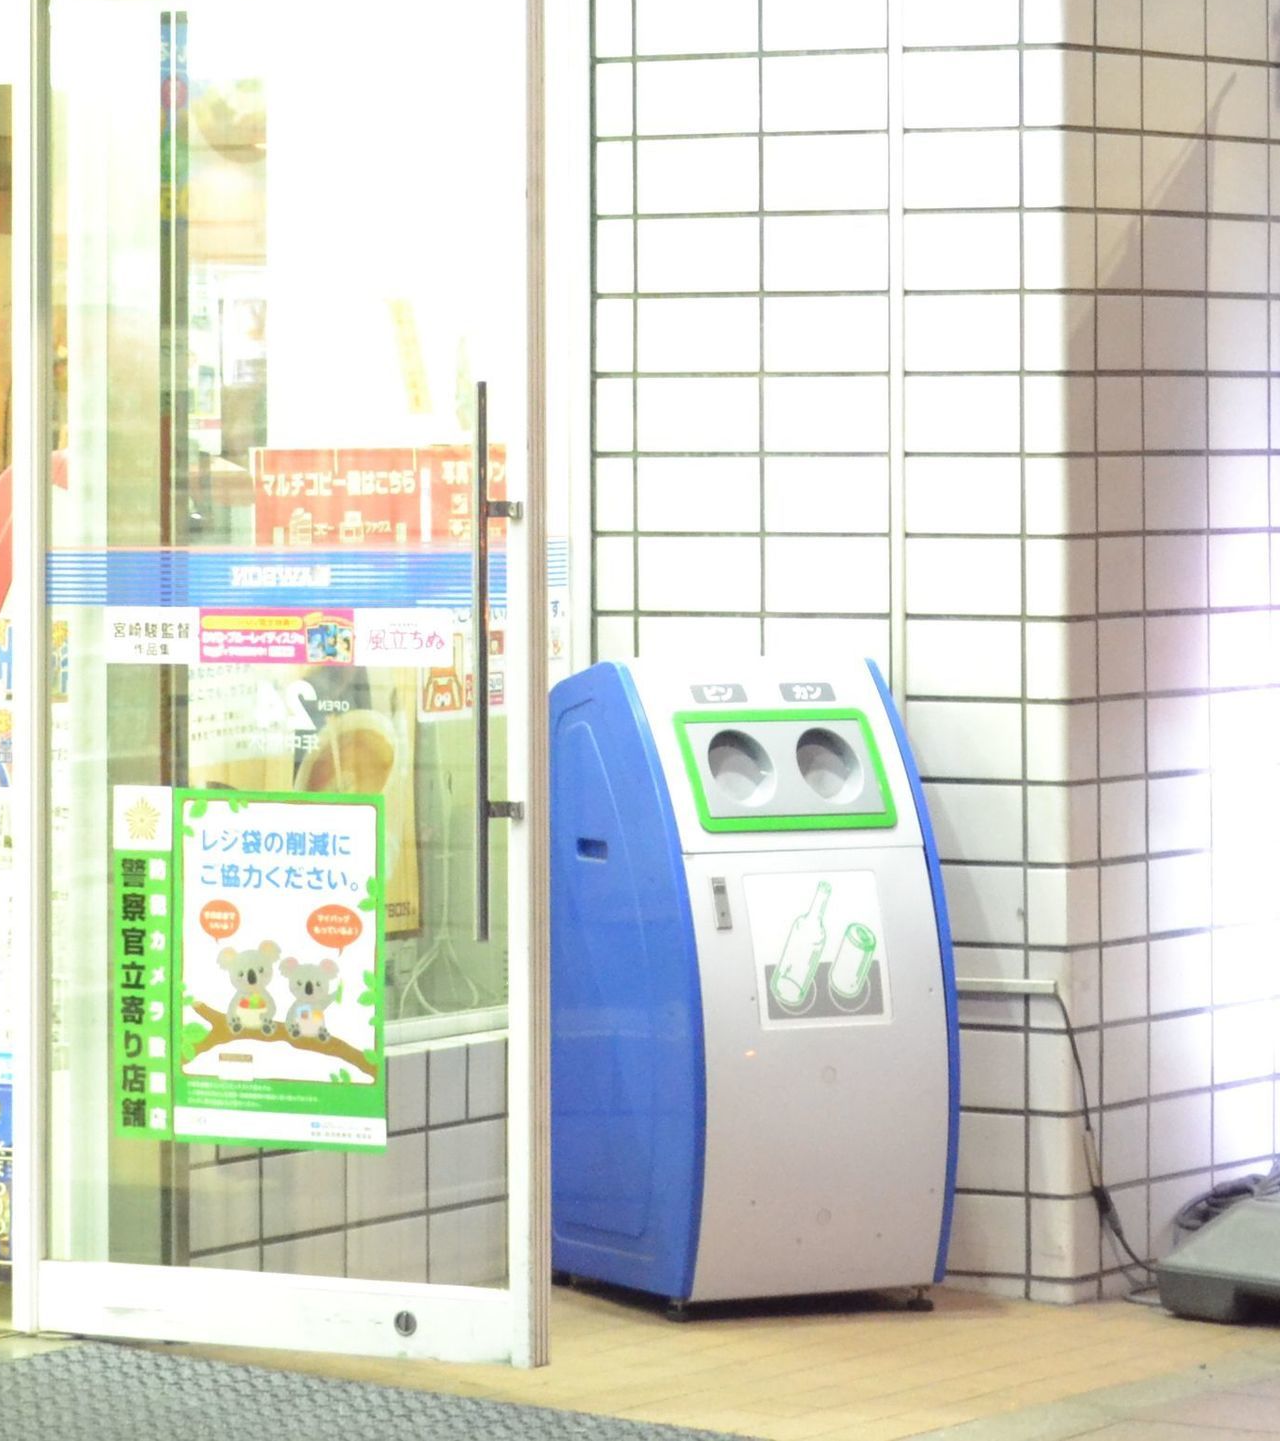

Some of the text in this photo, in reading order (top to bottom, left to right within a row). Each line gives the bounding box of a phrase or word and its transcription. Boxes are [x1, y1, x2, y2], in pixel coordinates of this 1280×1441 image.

[369, 628, 446, 650] 風立ちぬ
[201, 863, 359, 892] ご協力ください。
[121, 857, 147, 1129] 警察官立寄り店舗
